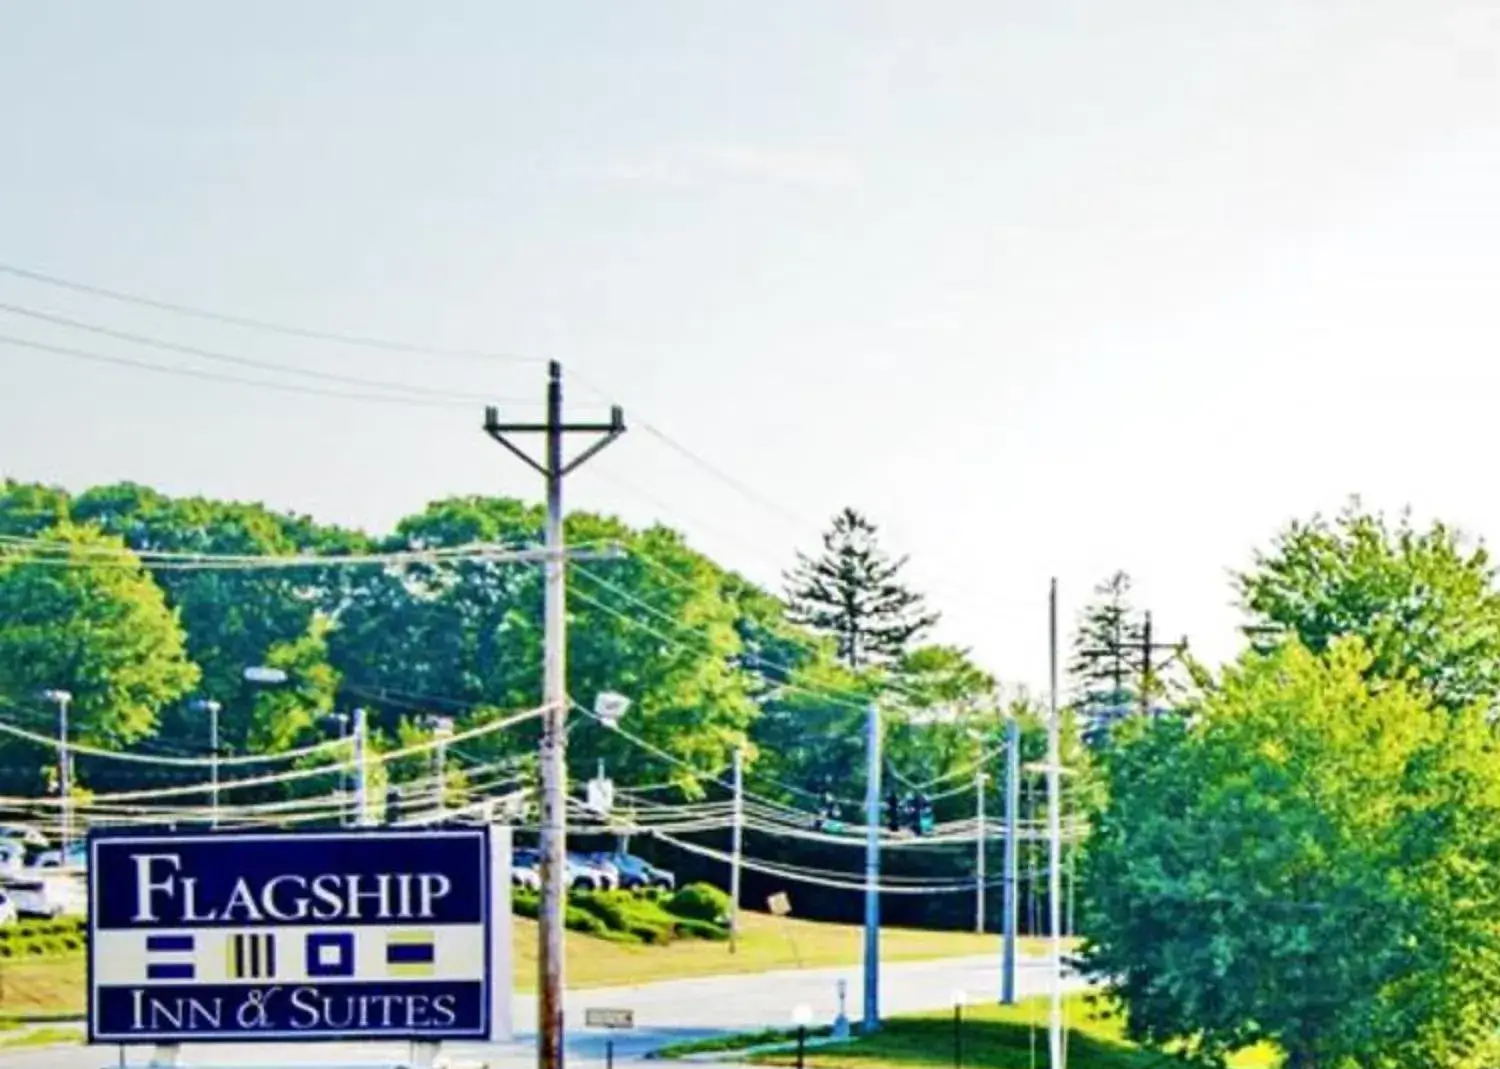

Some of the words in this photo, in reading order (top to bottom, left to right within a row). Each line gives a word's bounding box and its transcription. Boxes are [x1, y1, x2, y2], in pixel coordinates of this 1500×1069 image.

[129, 853, 452, 922] FLAGSHIP
[131, 990, 222, 1030] INN
[236, 986, 282, 1029] &
[290, 987, 456, 1029] SUITES
